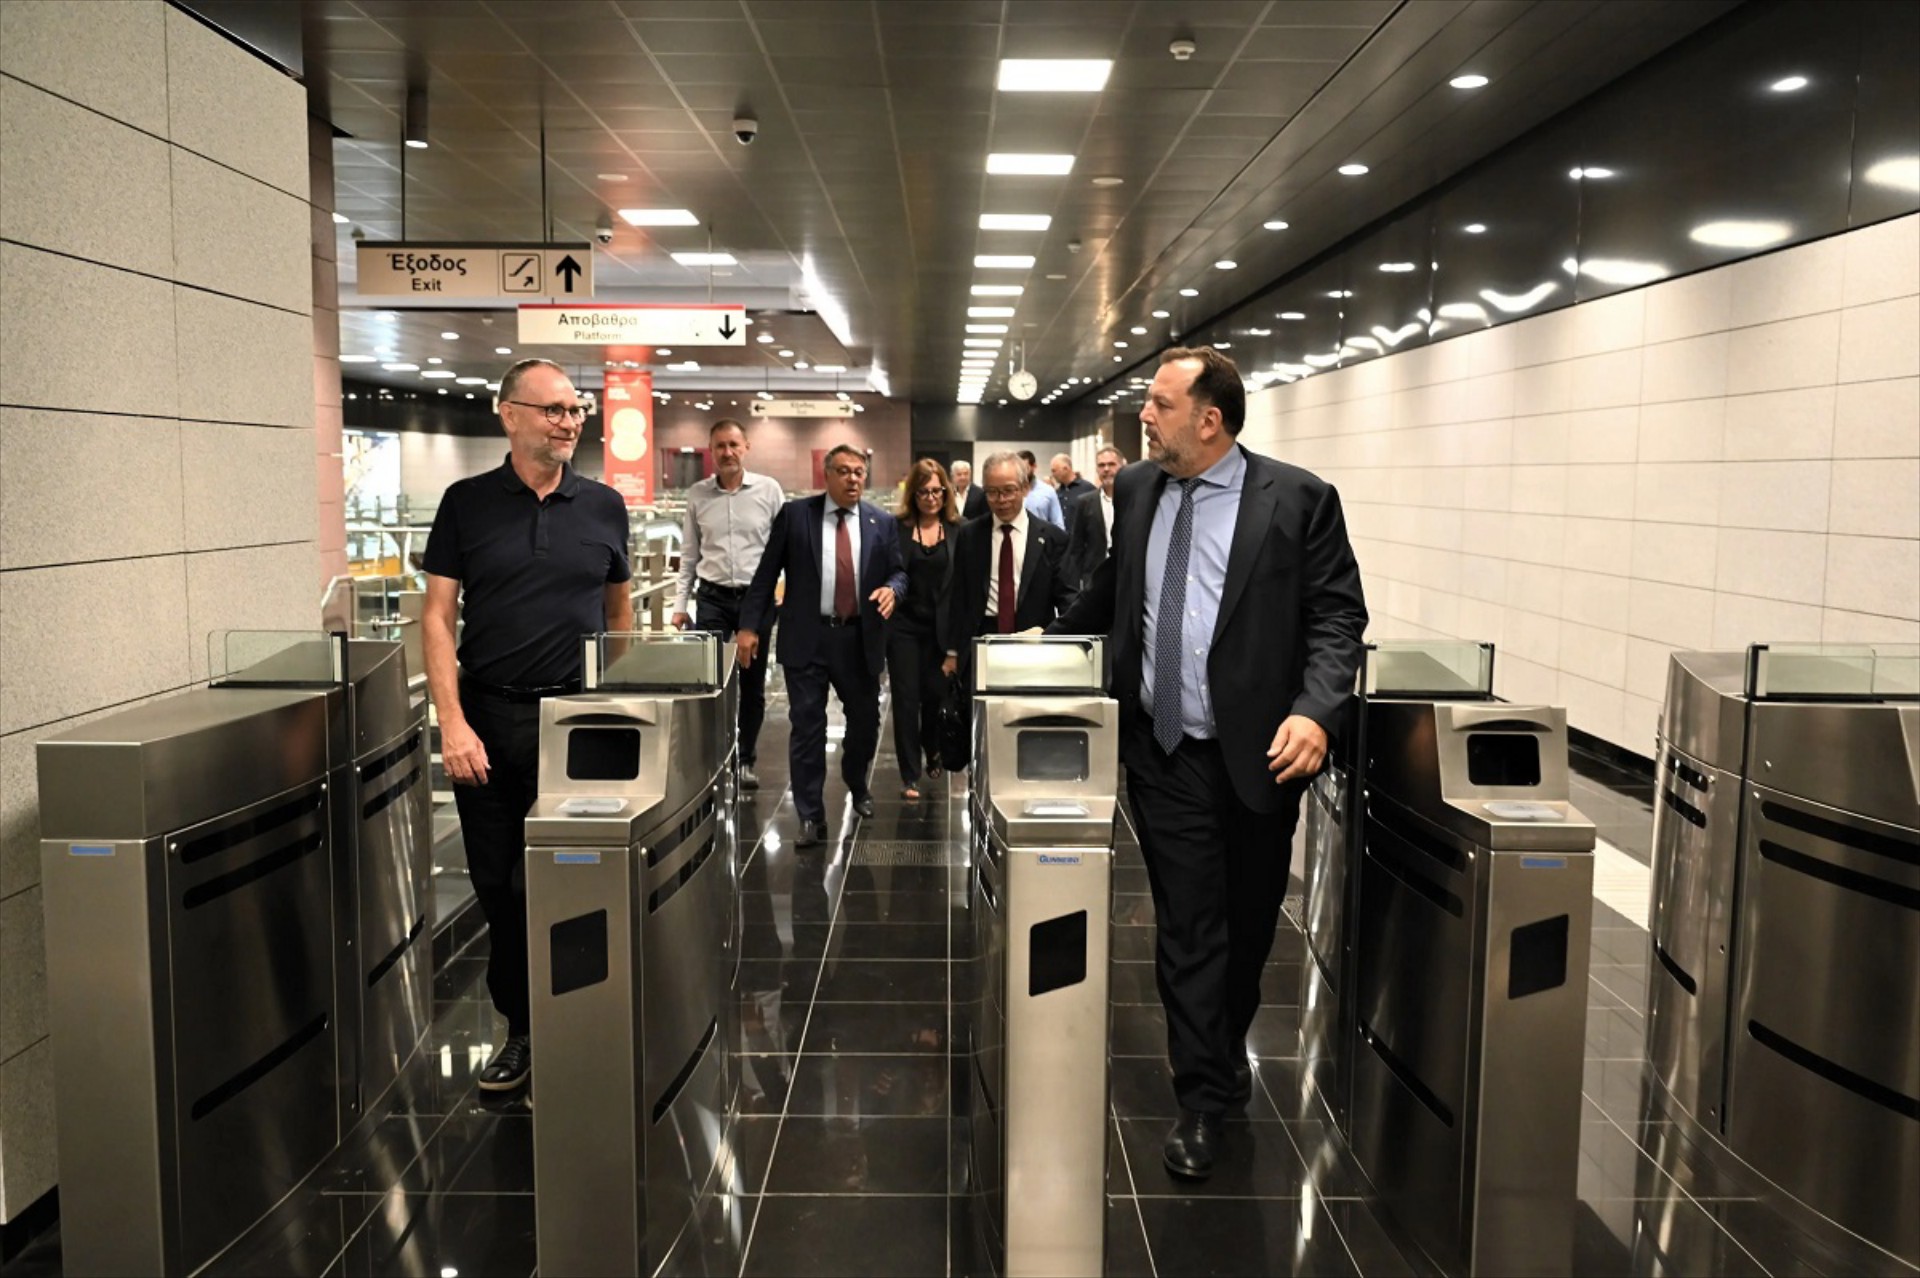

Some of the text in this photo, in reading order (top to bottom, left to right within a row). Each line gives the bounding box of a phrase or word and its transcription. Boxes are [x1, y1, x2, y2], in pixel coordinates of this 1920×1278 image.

[386, 253, 467, 276] Έξοδος
[411, 278, 442, 292] Exit
[573, 330, 623, 341] Platform
